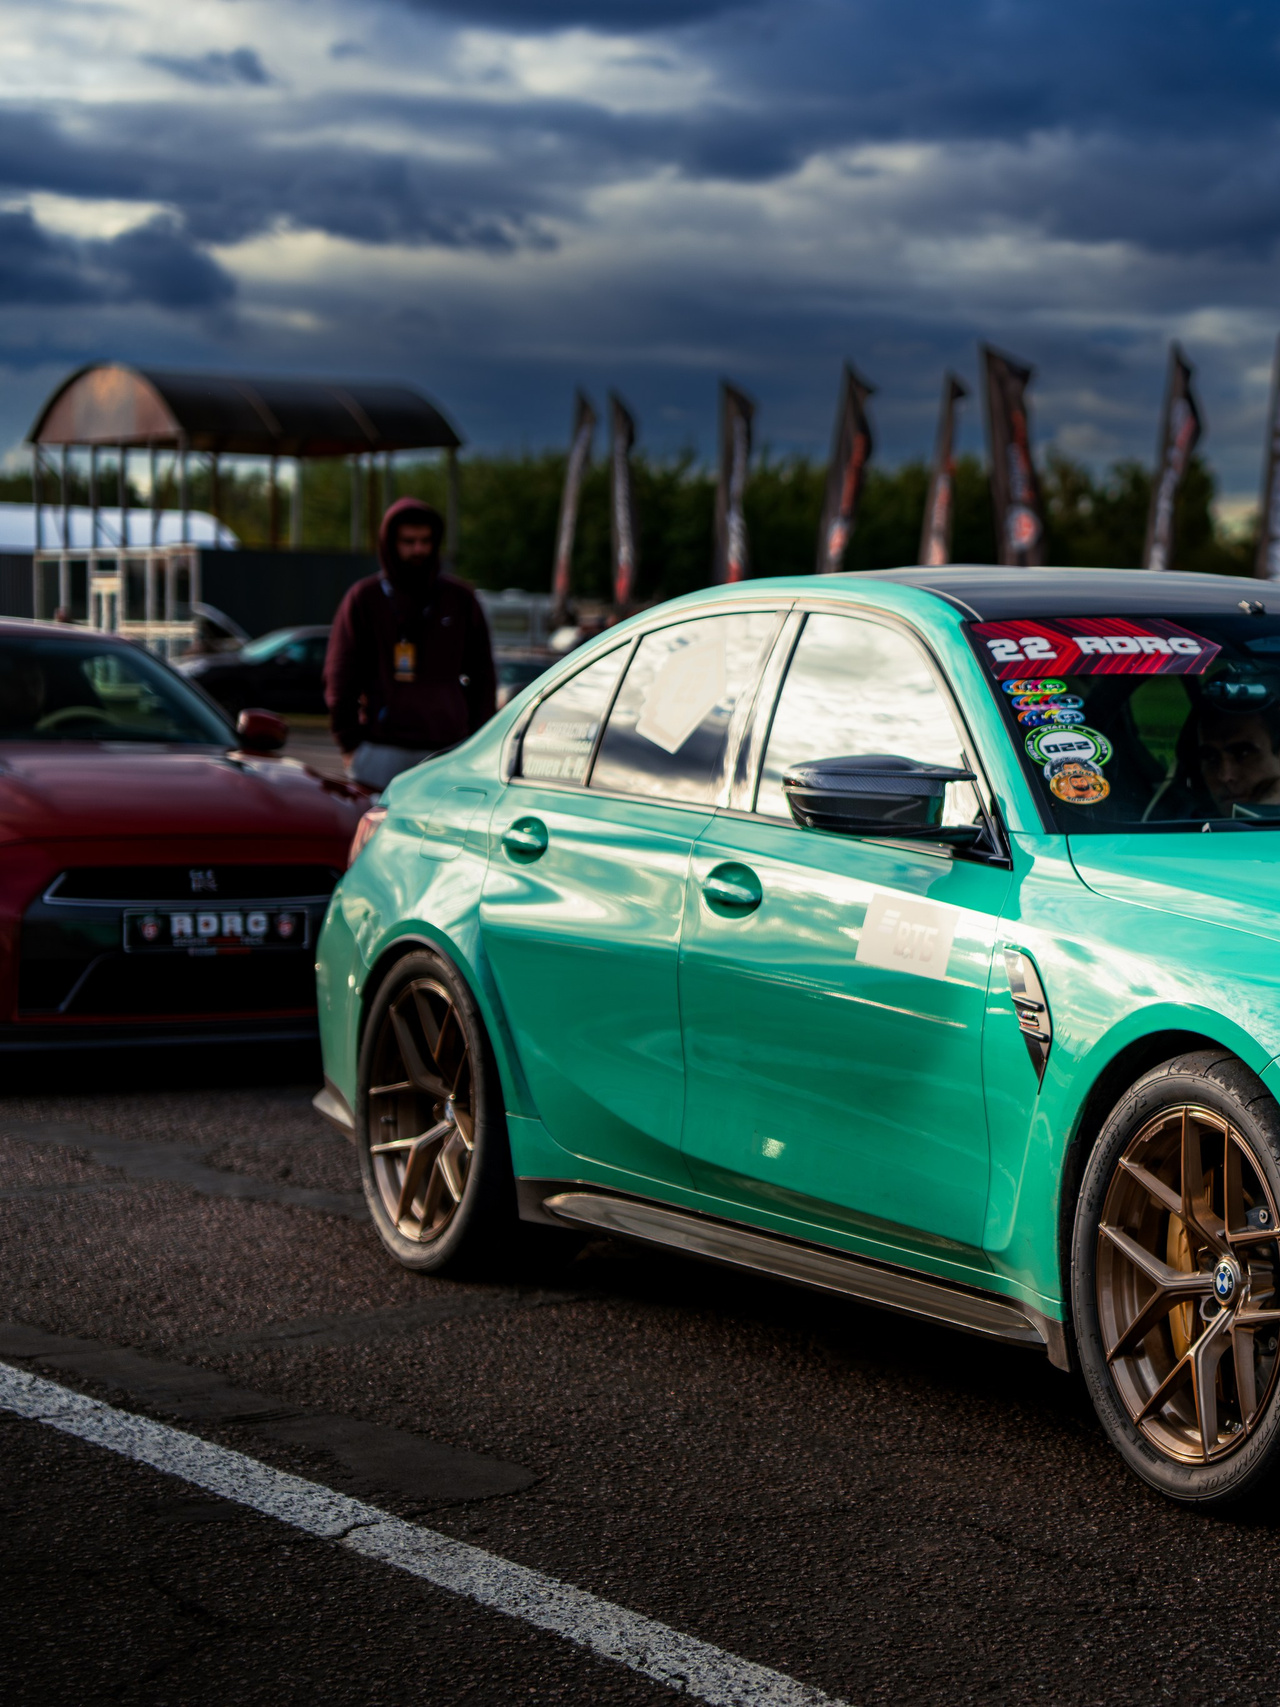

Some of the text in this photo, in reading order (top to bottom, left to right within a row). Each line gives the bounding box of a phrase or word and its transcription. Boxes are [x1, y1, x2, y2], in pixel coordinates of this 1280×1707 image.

[987, 637, 1057, 662] 22
[170, 912, 269, 937] RDRC
[1197, 1422, 1271, 1493] THOMPSON
